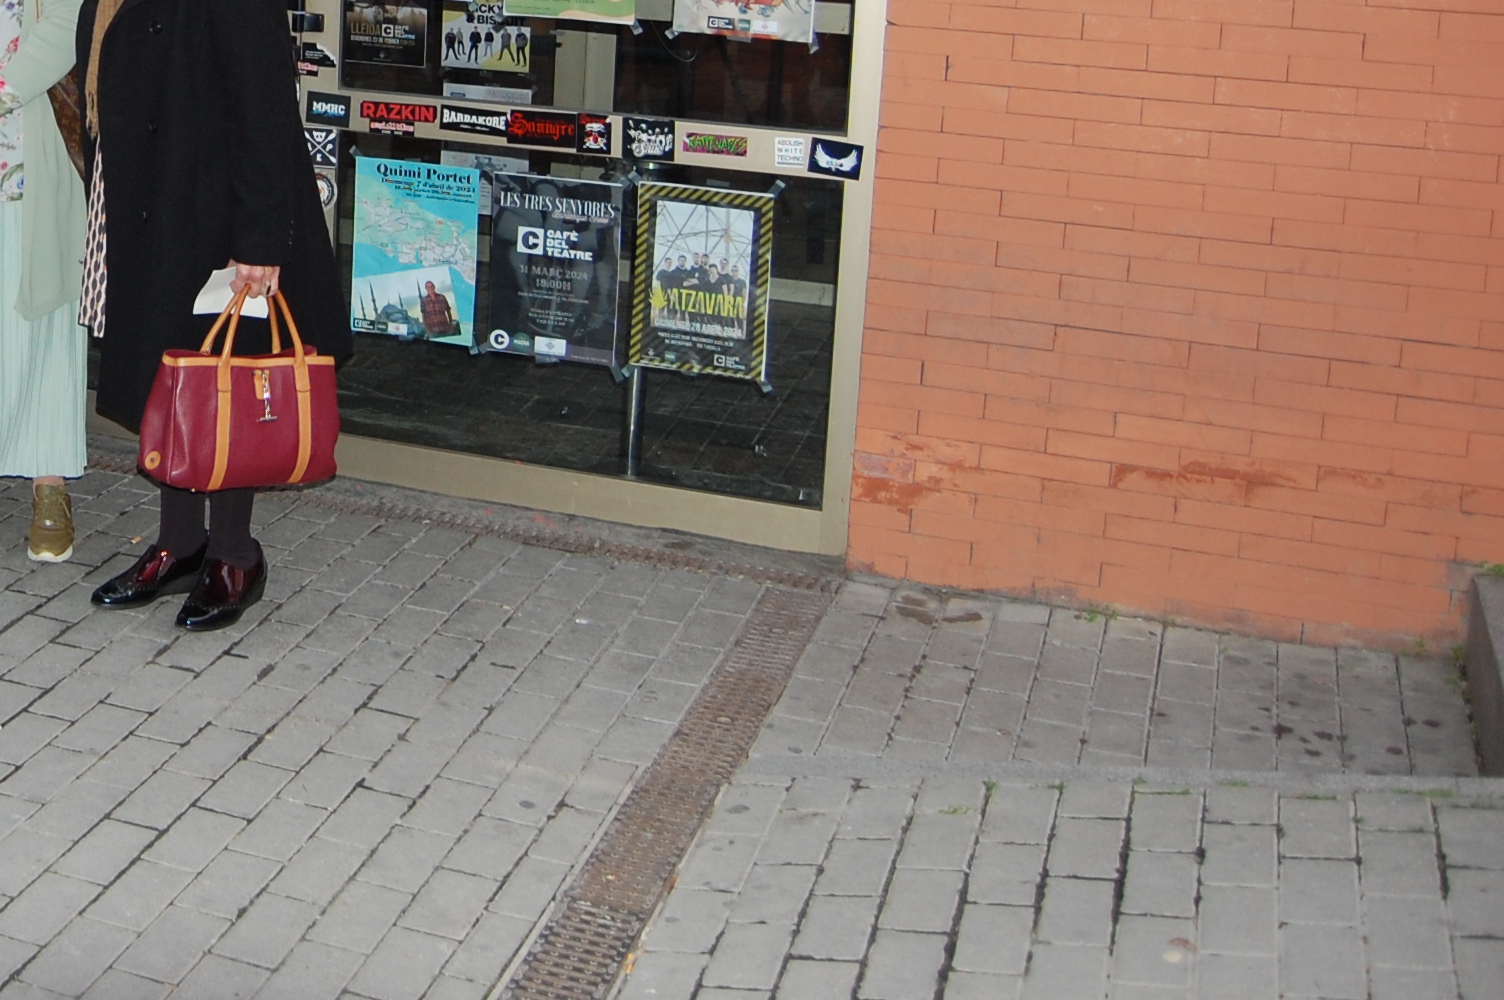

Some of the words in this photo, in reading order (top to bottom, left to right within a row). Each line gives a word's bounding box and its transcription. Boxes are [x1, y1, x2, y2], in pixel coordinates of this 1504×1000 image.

[351, 22, 380, 35] LLEIDA
[312, 101, 346, 115] MMHC
[362, 101, 435, 122] RAZKIN
[443, 108, 506, 130] BARBAKORE
[377, 163, 421, 179] Quimi
[426, 168, 473, 184] Portet
[500, 191, 521, 208] LES
[523, 194, 553, 211] TRES
[556, 197, 615, 218] SENYORES
[546, 240, 568, 249] DEL
[547, 248, 593, 261] TEATRE
[565, 270, 588, 280] 2024
